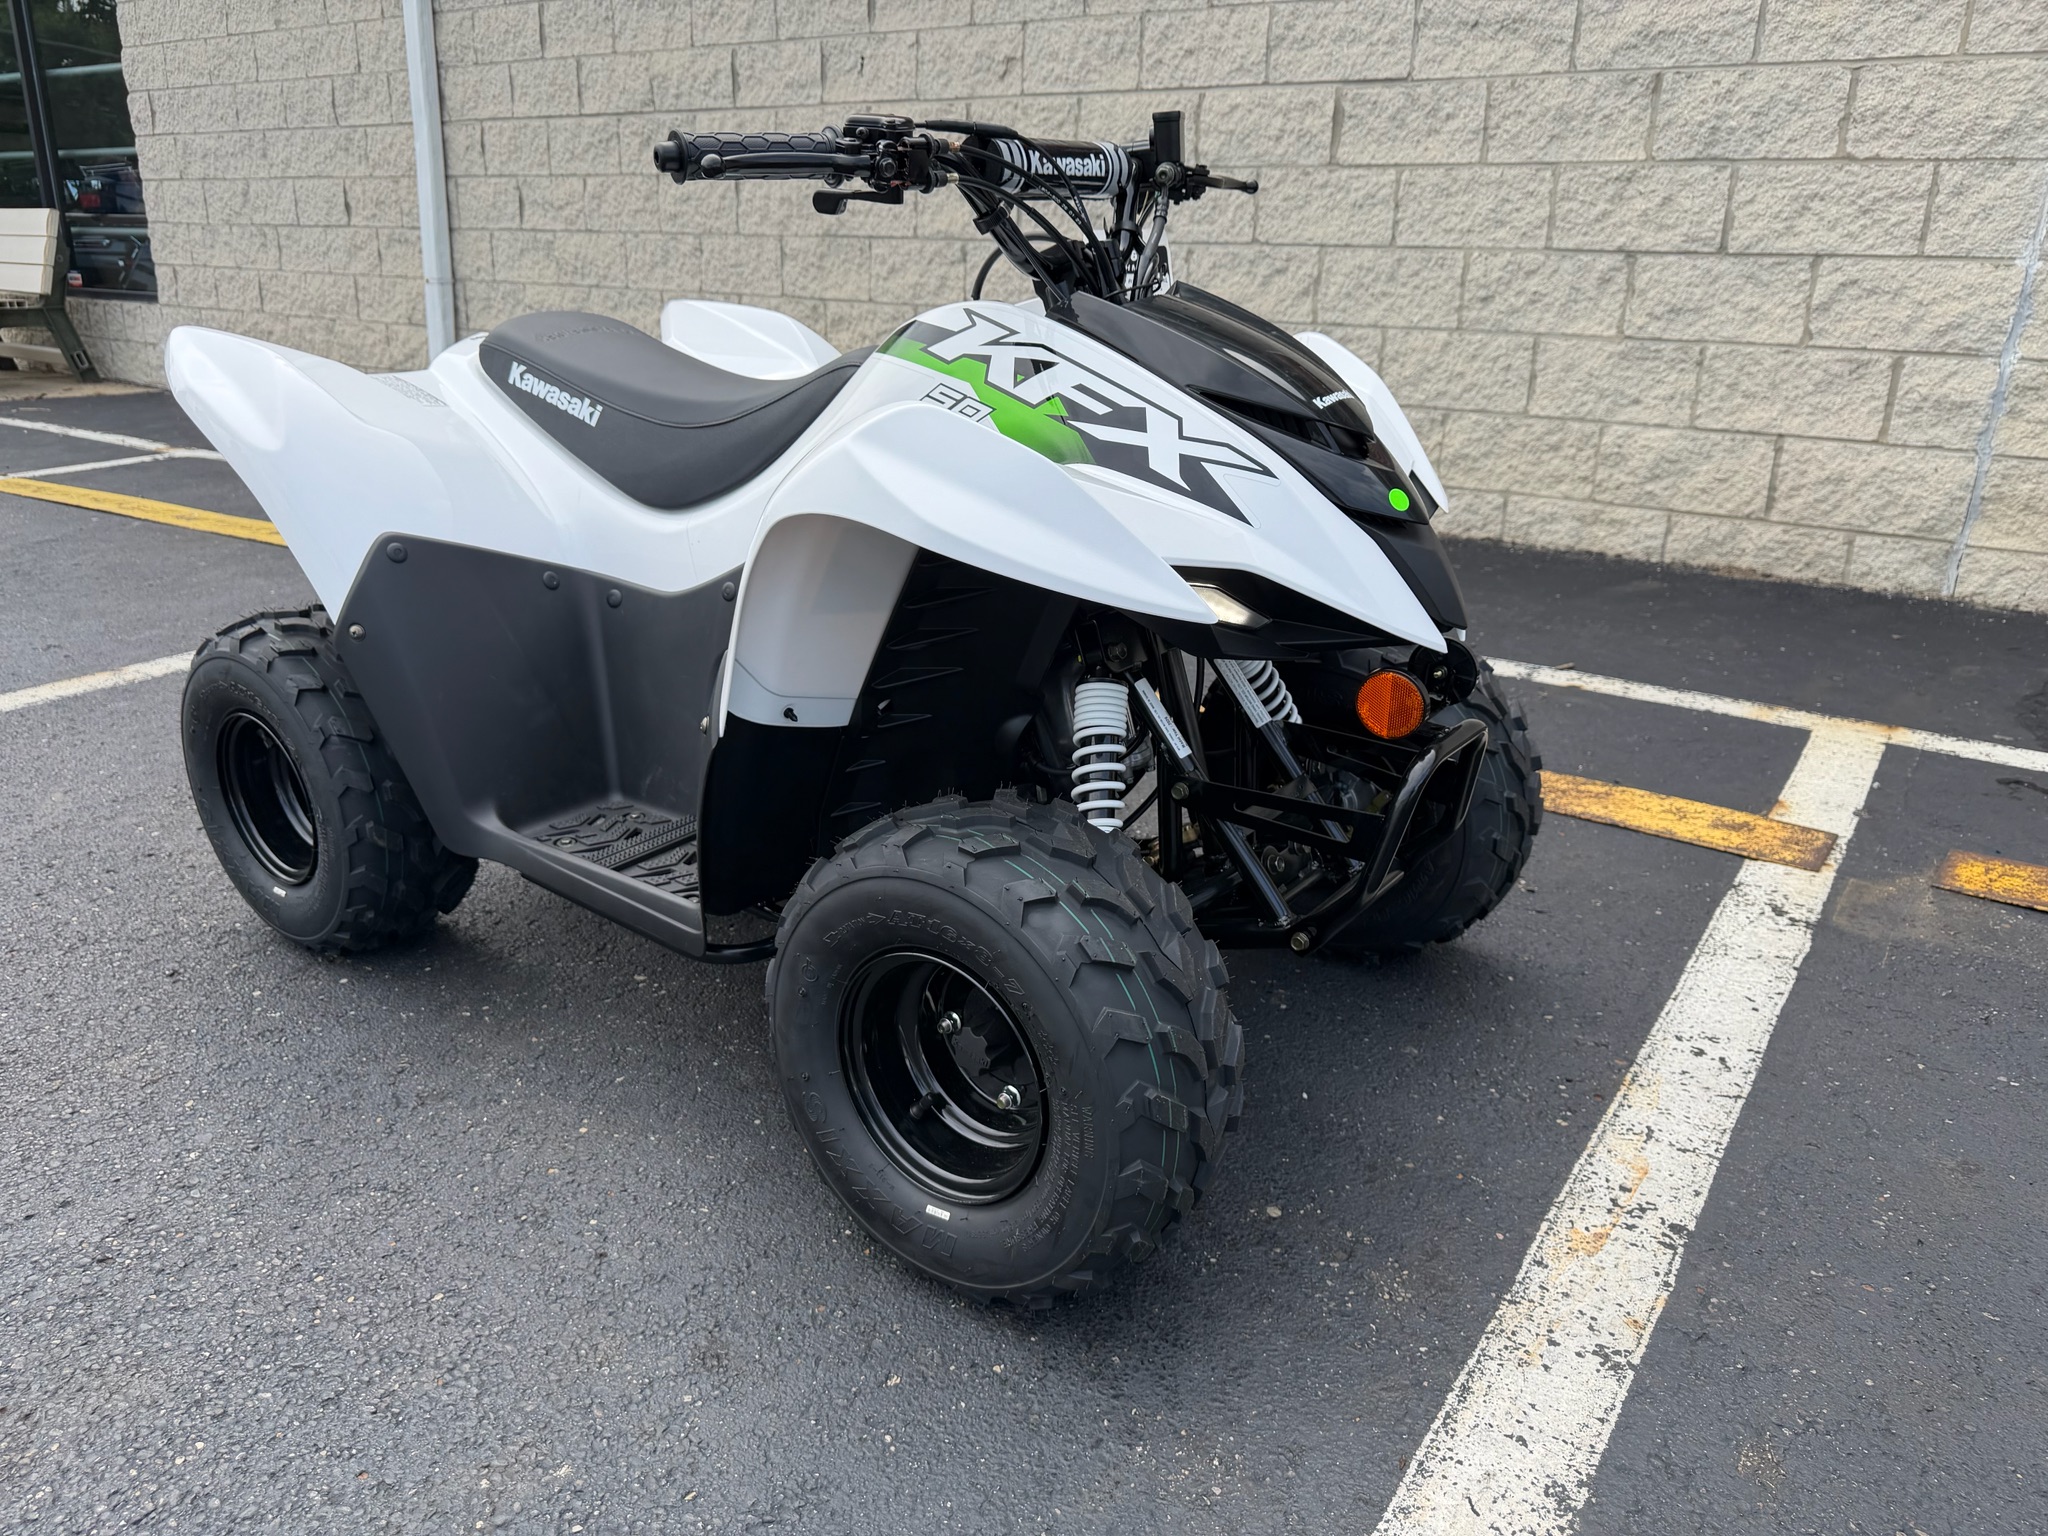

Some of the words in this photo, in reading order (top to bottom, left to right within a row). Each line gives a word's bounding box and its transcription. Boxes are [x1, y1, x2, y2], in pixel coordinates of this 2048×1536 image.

[1028, 149, 1106, 177] Kawasaki
[507, 360, 604, 428] Kawasaki
[919, 308, 1280, 515] KFX
[920, 383, 997, 422] 50
[1081, 1105, 1095, 1159] WARNING
[802, 1091, 959, 1257] MAXXIS
